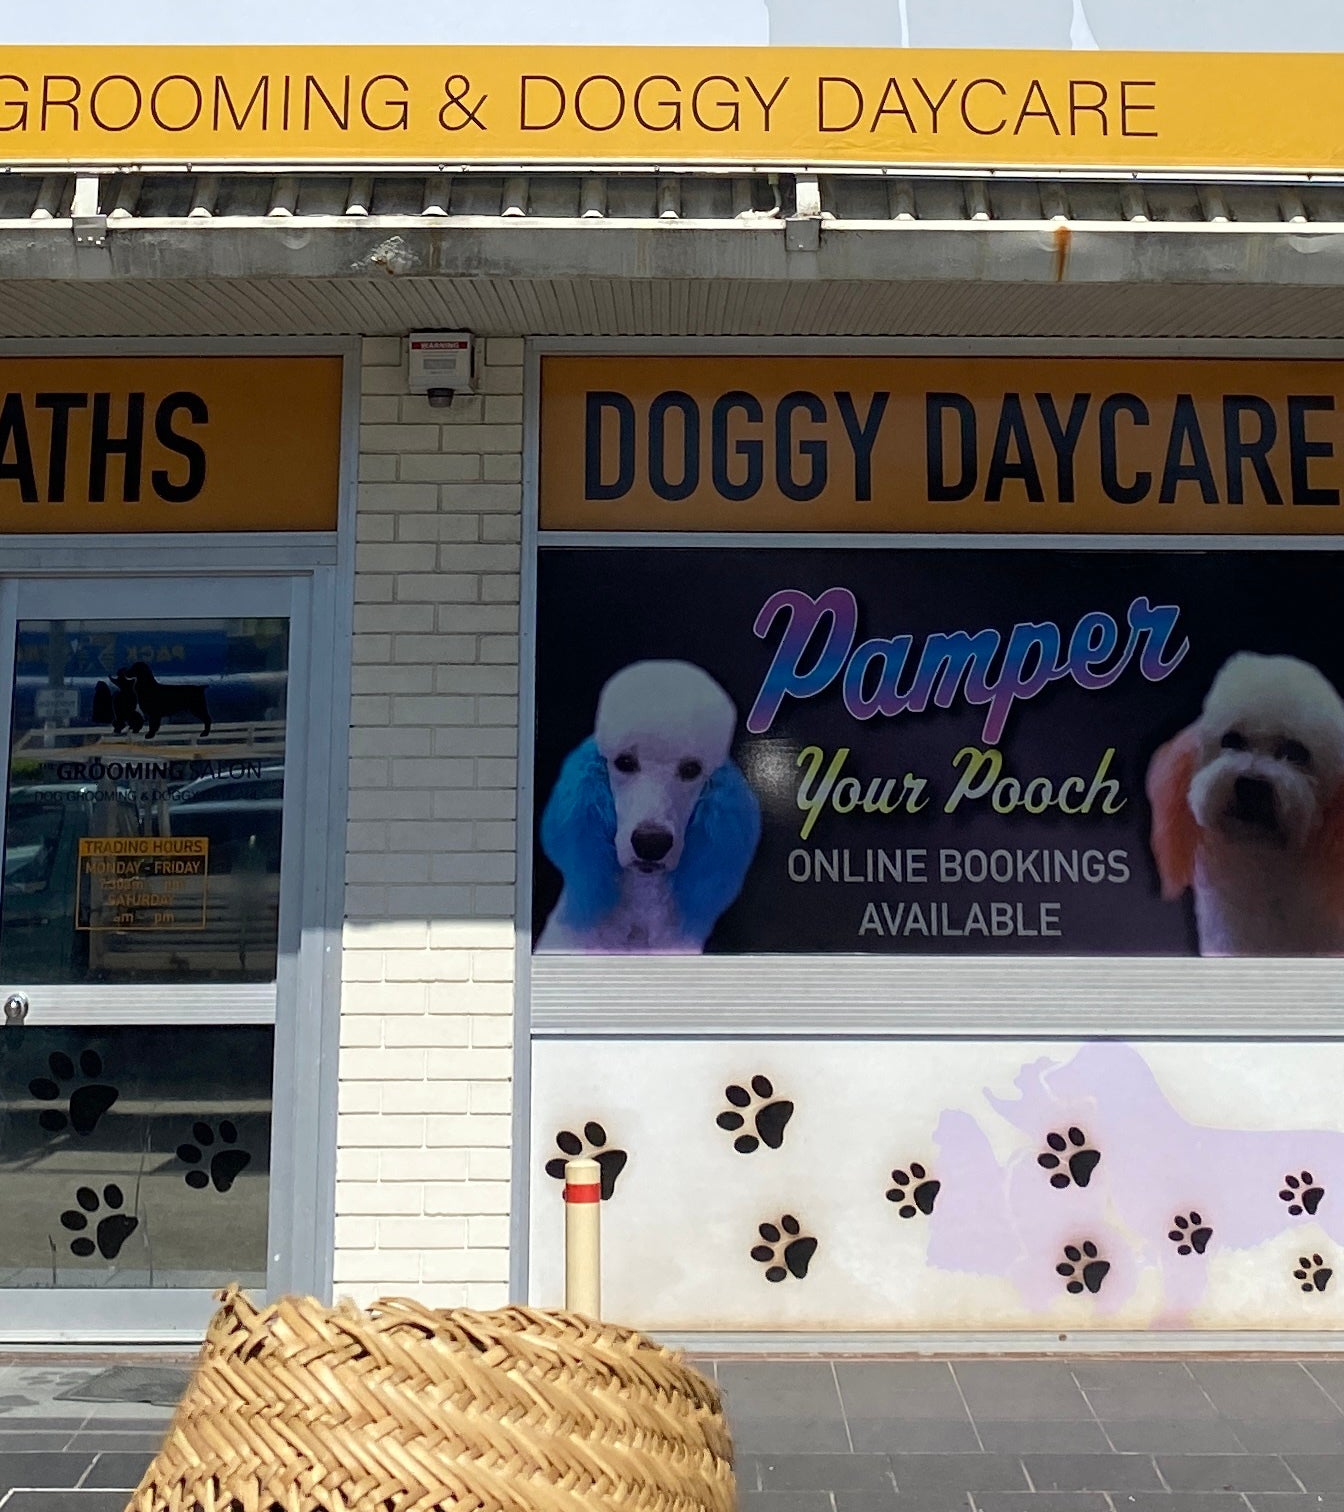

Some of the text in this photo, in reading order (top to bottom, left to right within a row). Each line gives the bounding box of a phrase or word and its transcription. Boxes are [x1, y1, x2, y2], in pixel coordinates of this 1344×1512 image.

[438, 73, 488, 133] &
[519, 75, 791, 134] DOGGY
[817, 77, 1160, 138] DAYCARE
[584, 390, 1341, 506] DOGGY DAYCARE
[747, 587, 1190, 745] Pamper
[57, 761, 184, 782] GROOMING
[189, 760, 262, 780] SALON
[796, 746, 1127, 840] Your Pooch
[84, 840, 203, 854] TRADING HOURS
[85, 861, 141, 874] MONDAY
[154, 861, 201, 874] FRIDAY
[787, 848, 1131, 885] ONLINE BOOKINGS
[858, 901, 1063, 938] AVAILABLE
